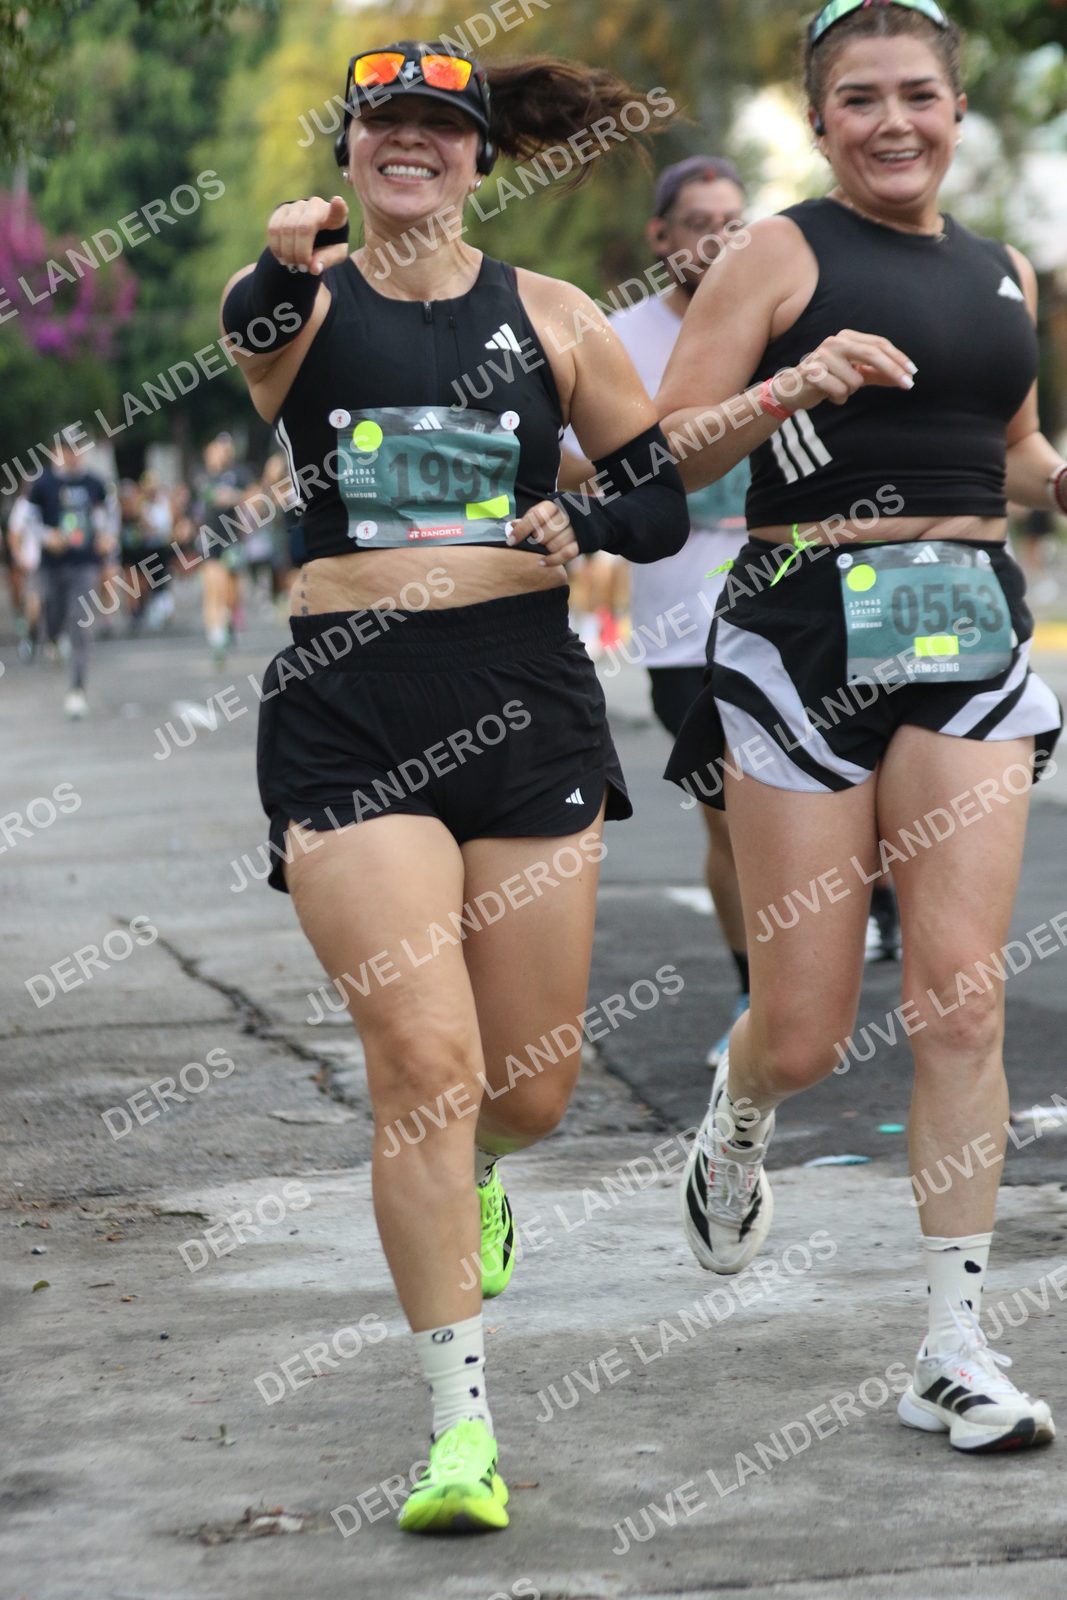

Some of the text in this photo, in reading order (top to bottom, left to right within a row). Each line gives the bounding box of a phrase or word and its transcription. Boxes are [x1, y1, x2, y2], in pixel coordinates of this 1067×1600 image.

[345, 477, 376, 485] SPLITS
[389, 449, 512, 504] 1997
[891, 584, 1004, 636] 0553
[907, 662, 959, 673] SAMSUNG
